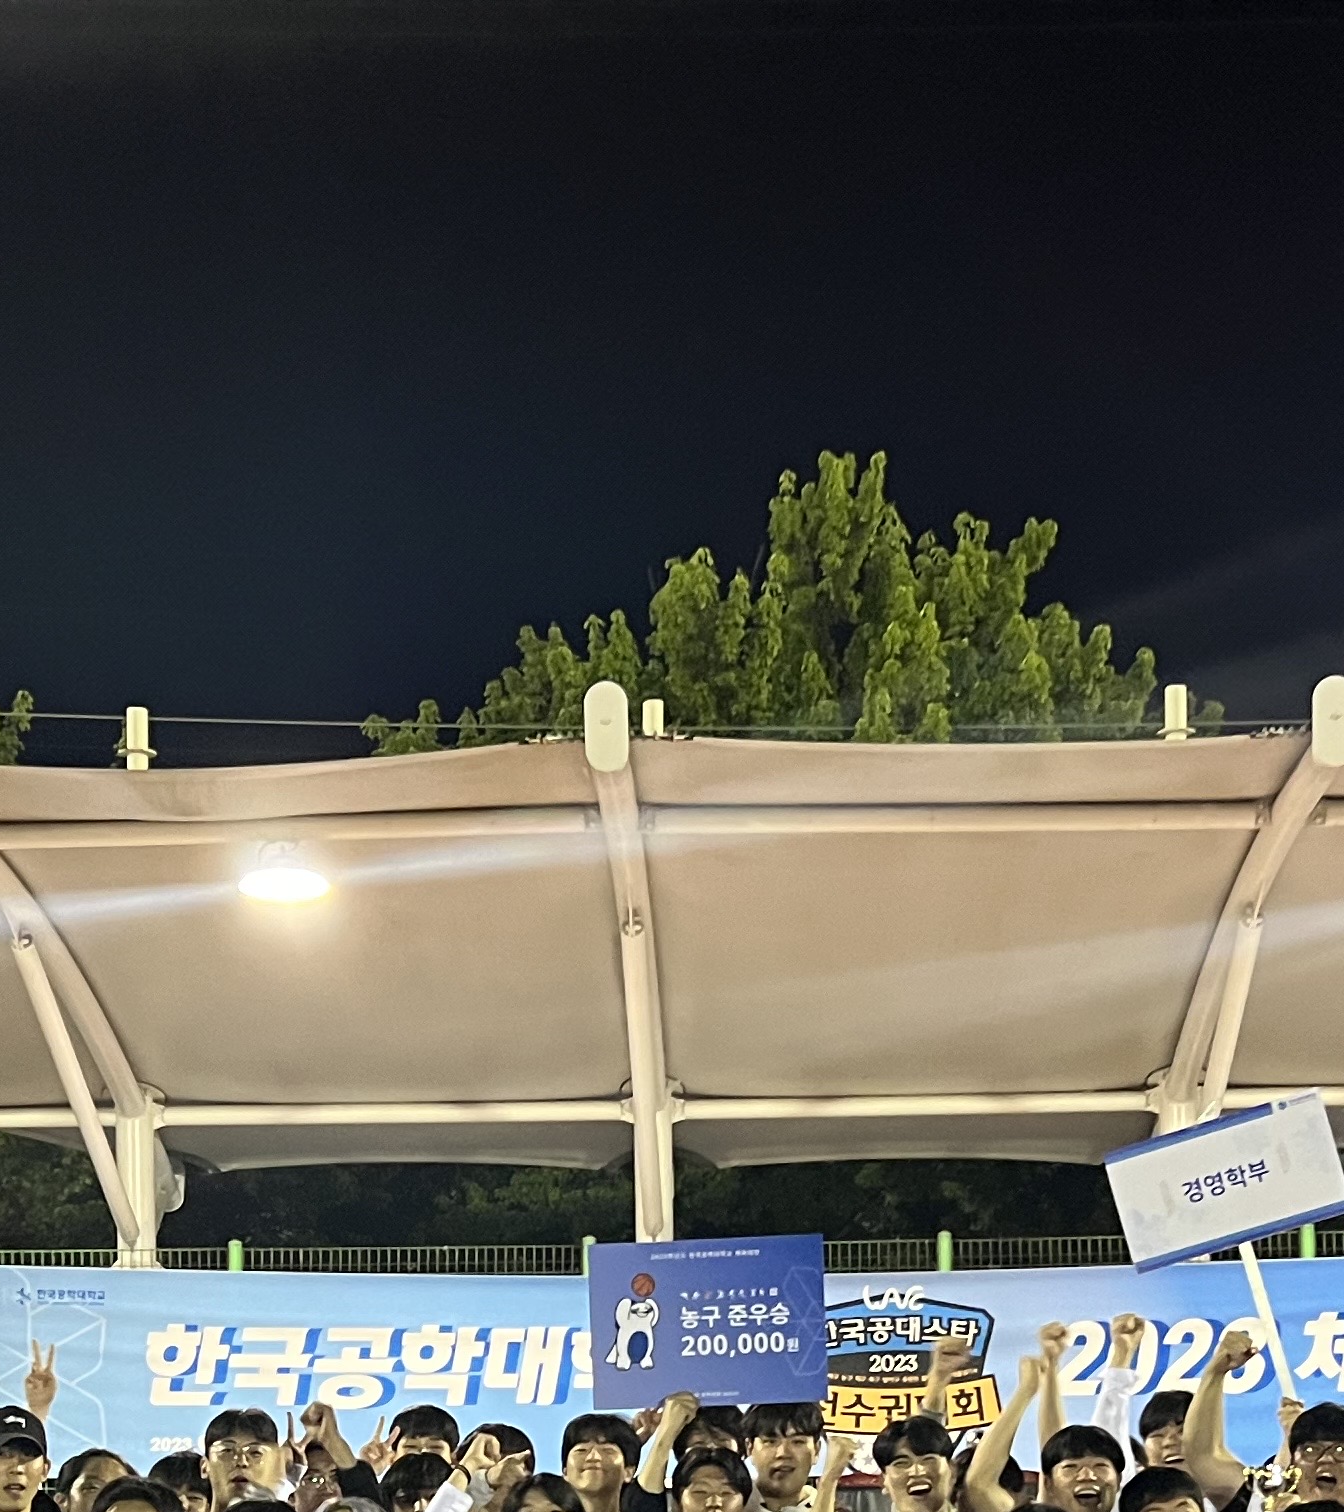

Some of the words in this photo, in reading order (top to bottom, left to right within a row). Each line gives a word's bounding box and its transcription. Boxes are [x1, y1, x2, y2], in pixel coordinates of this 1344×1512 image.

[1182, 1159, 1269, 1203] 경영학부
[680, 1306, 721, 1329] 농구
[727, 1303, 790, 1327] 준우승
[681, 1331, 799, 1358] 200,000원
[145, 1322, 594, 1410] 한국공학대
[869, 1354, 919, 1373] 2023
